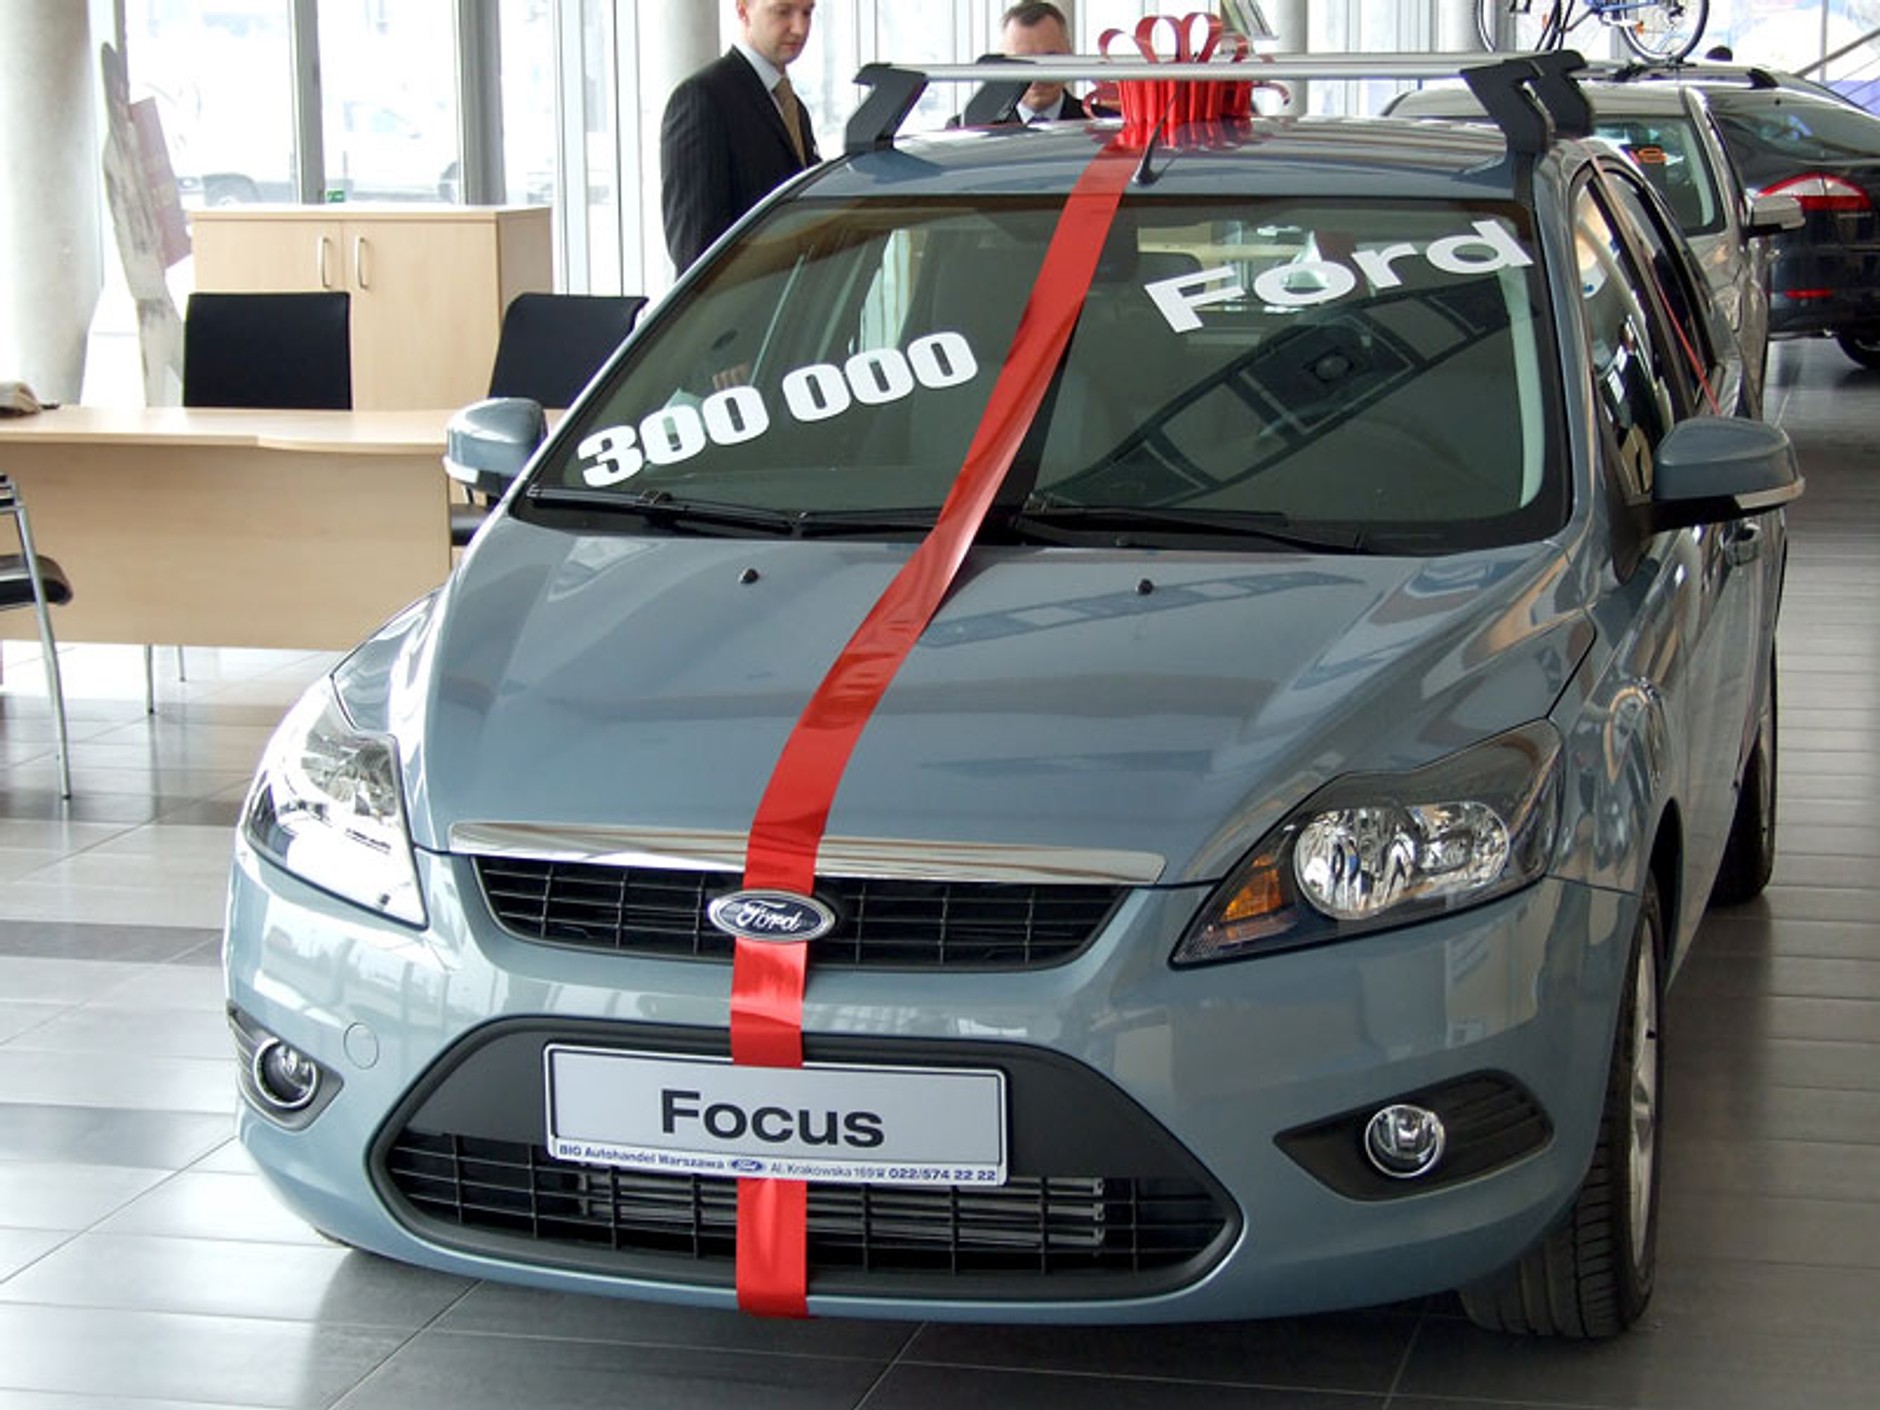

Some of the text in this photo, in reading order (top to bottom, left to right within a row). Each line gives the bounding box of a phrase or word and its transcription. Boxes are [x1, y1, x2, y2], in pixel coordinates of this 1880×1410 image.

[1144, 219, 1534, 333] Ford
[577, 331, 978, 488] 300 000
[736, 900, 802, 931] Ford
[661, 1089, 885, 1148] Focus
[585, 1147, 656, 1163] Autohandel
[658, 1154, 724, 1169] Warszawa
[787, 1164, 852, 1176] Krakowska
[888, 1167, 950, 1180] 022/574
[954, 1170, 973, 1181] 22
[977, 1170, 996, 1181] 22
